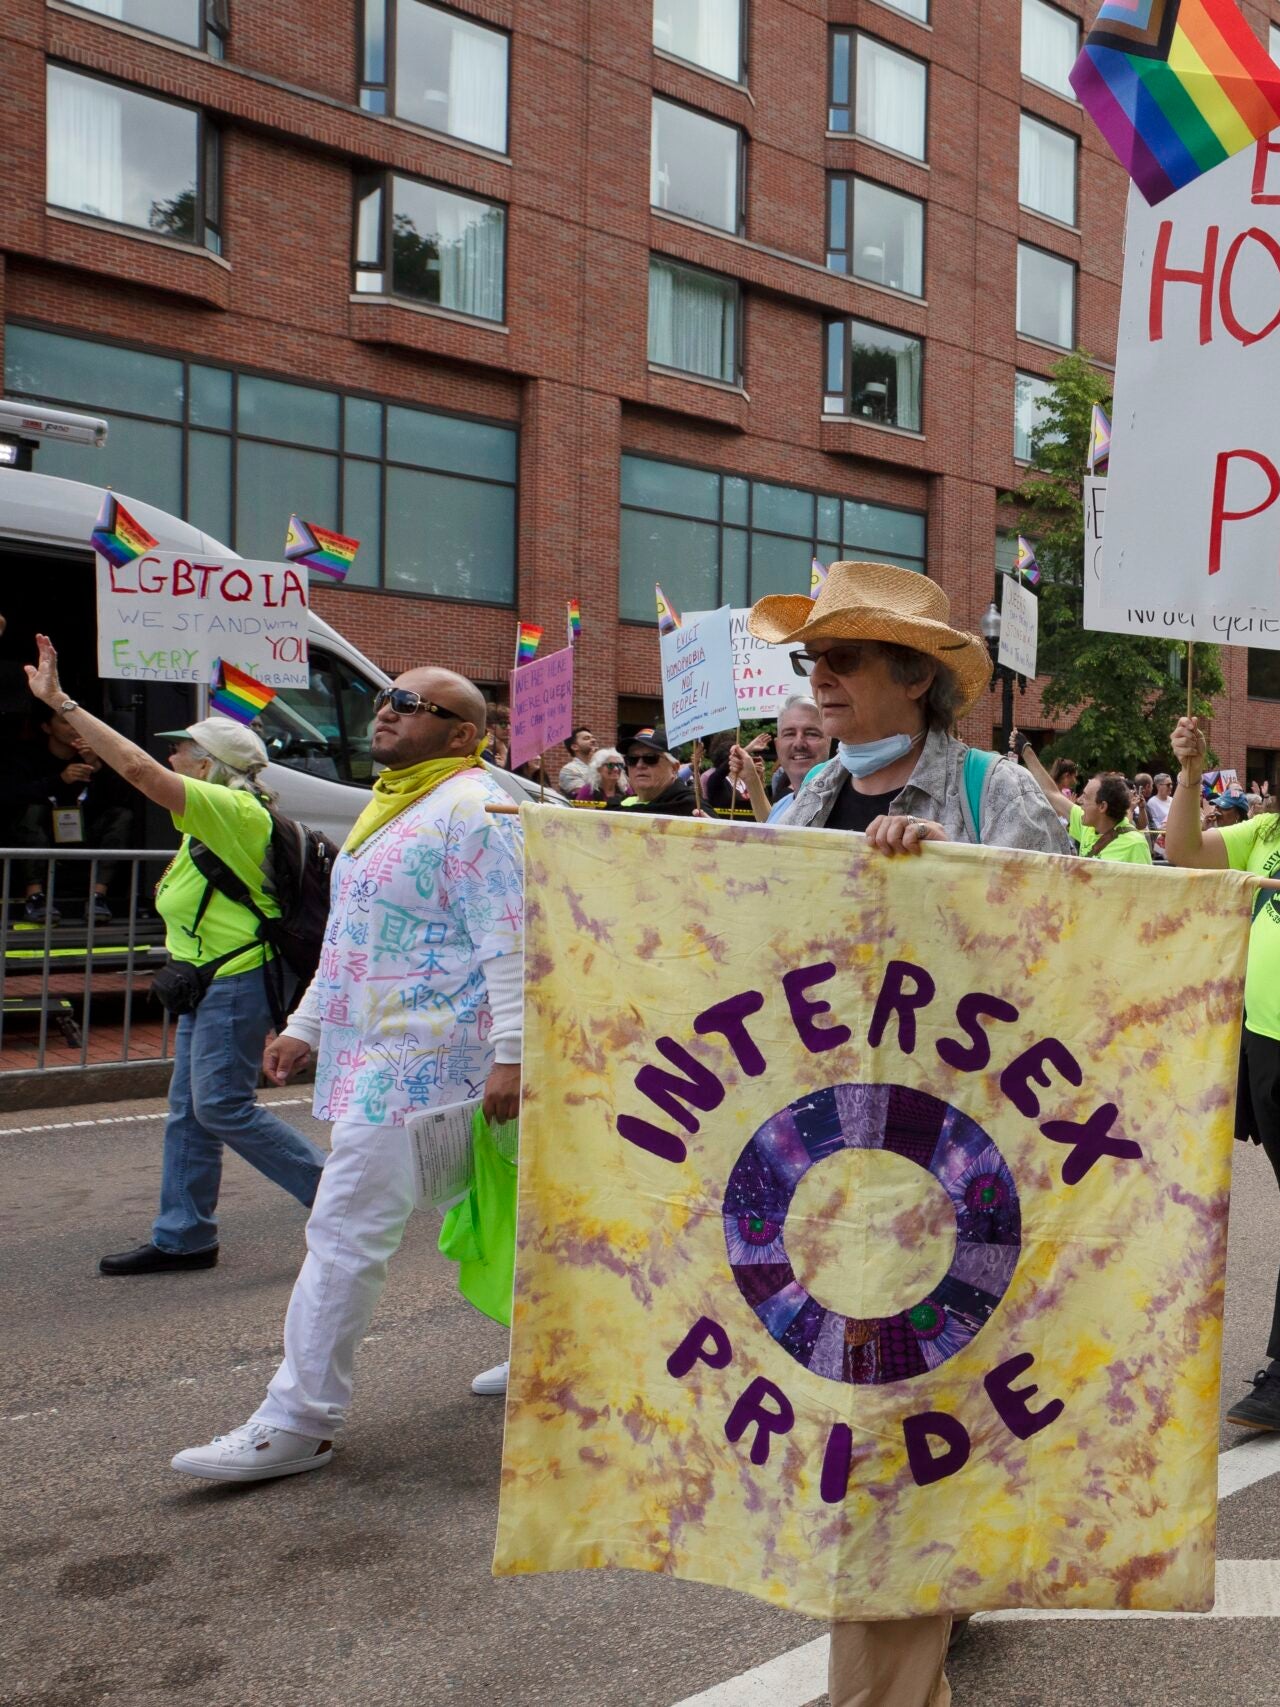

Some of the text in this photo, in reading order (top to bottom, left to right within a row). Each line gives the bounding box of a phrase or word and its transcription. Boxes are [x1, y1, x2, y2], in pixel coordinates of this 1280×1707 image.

[108, 556, 307, 608] LGBTQIA
[117, 608, 299, 635] WE STAND WITH
[265, 636, 309, 663] YOU
[676, 623, 701, 650] EVICT
[112, 639, 200, 670] EVERY
[682, 671, 695, 691] NOT
[616, 960, 1143, 1186] INTERSEX
[666, 1315, 1065, 1504] PRIDE
